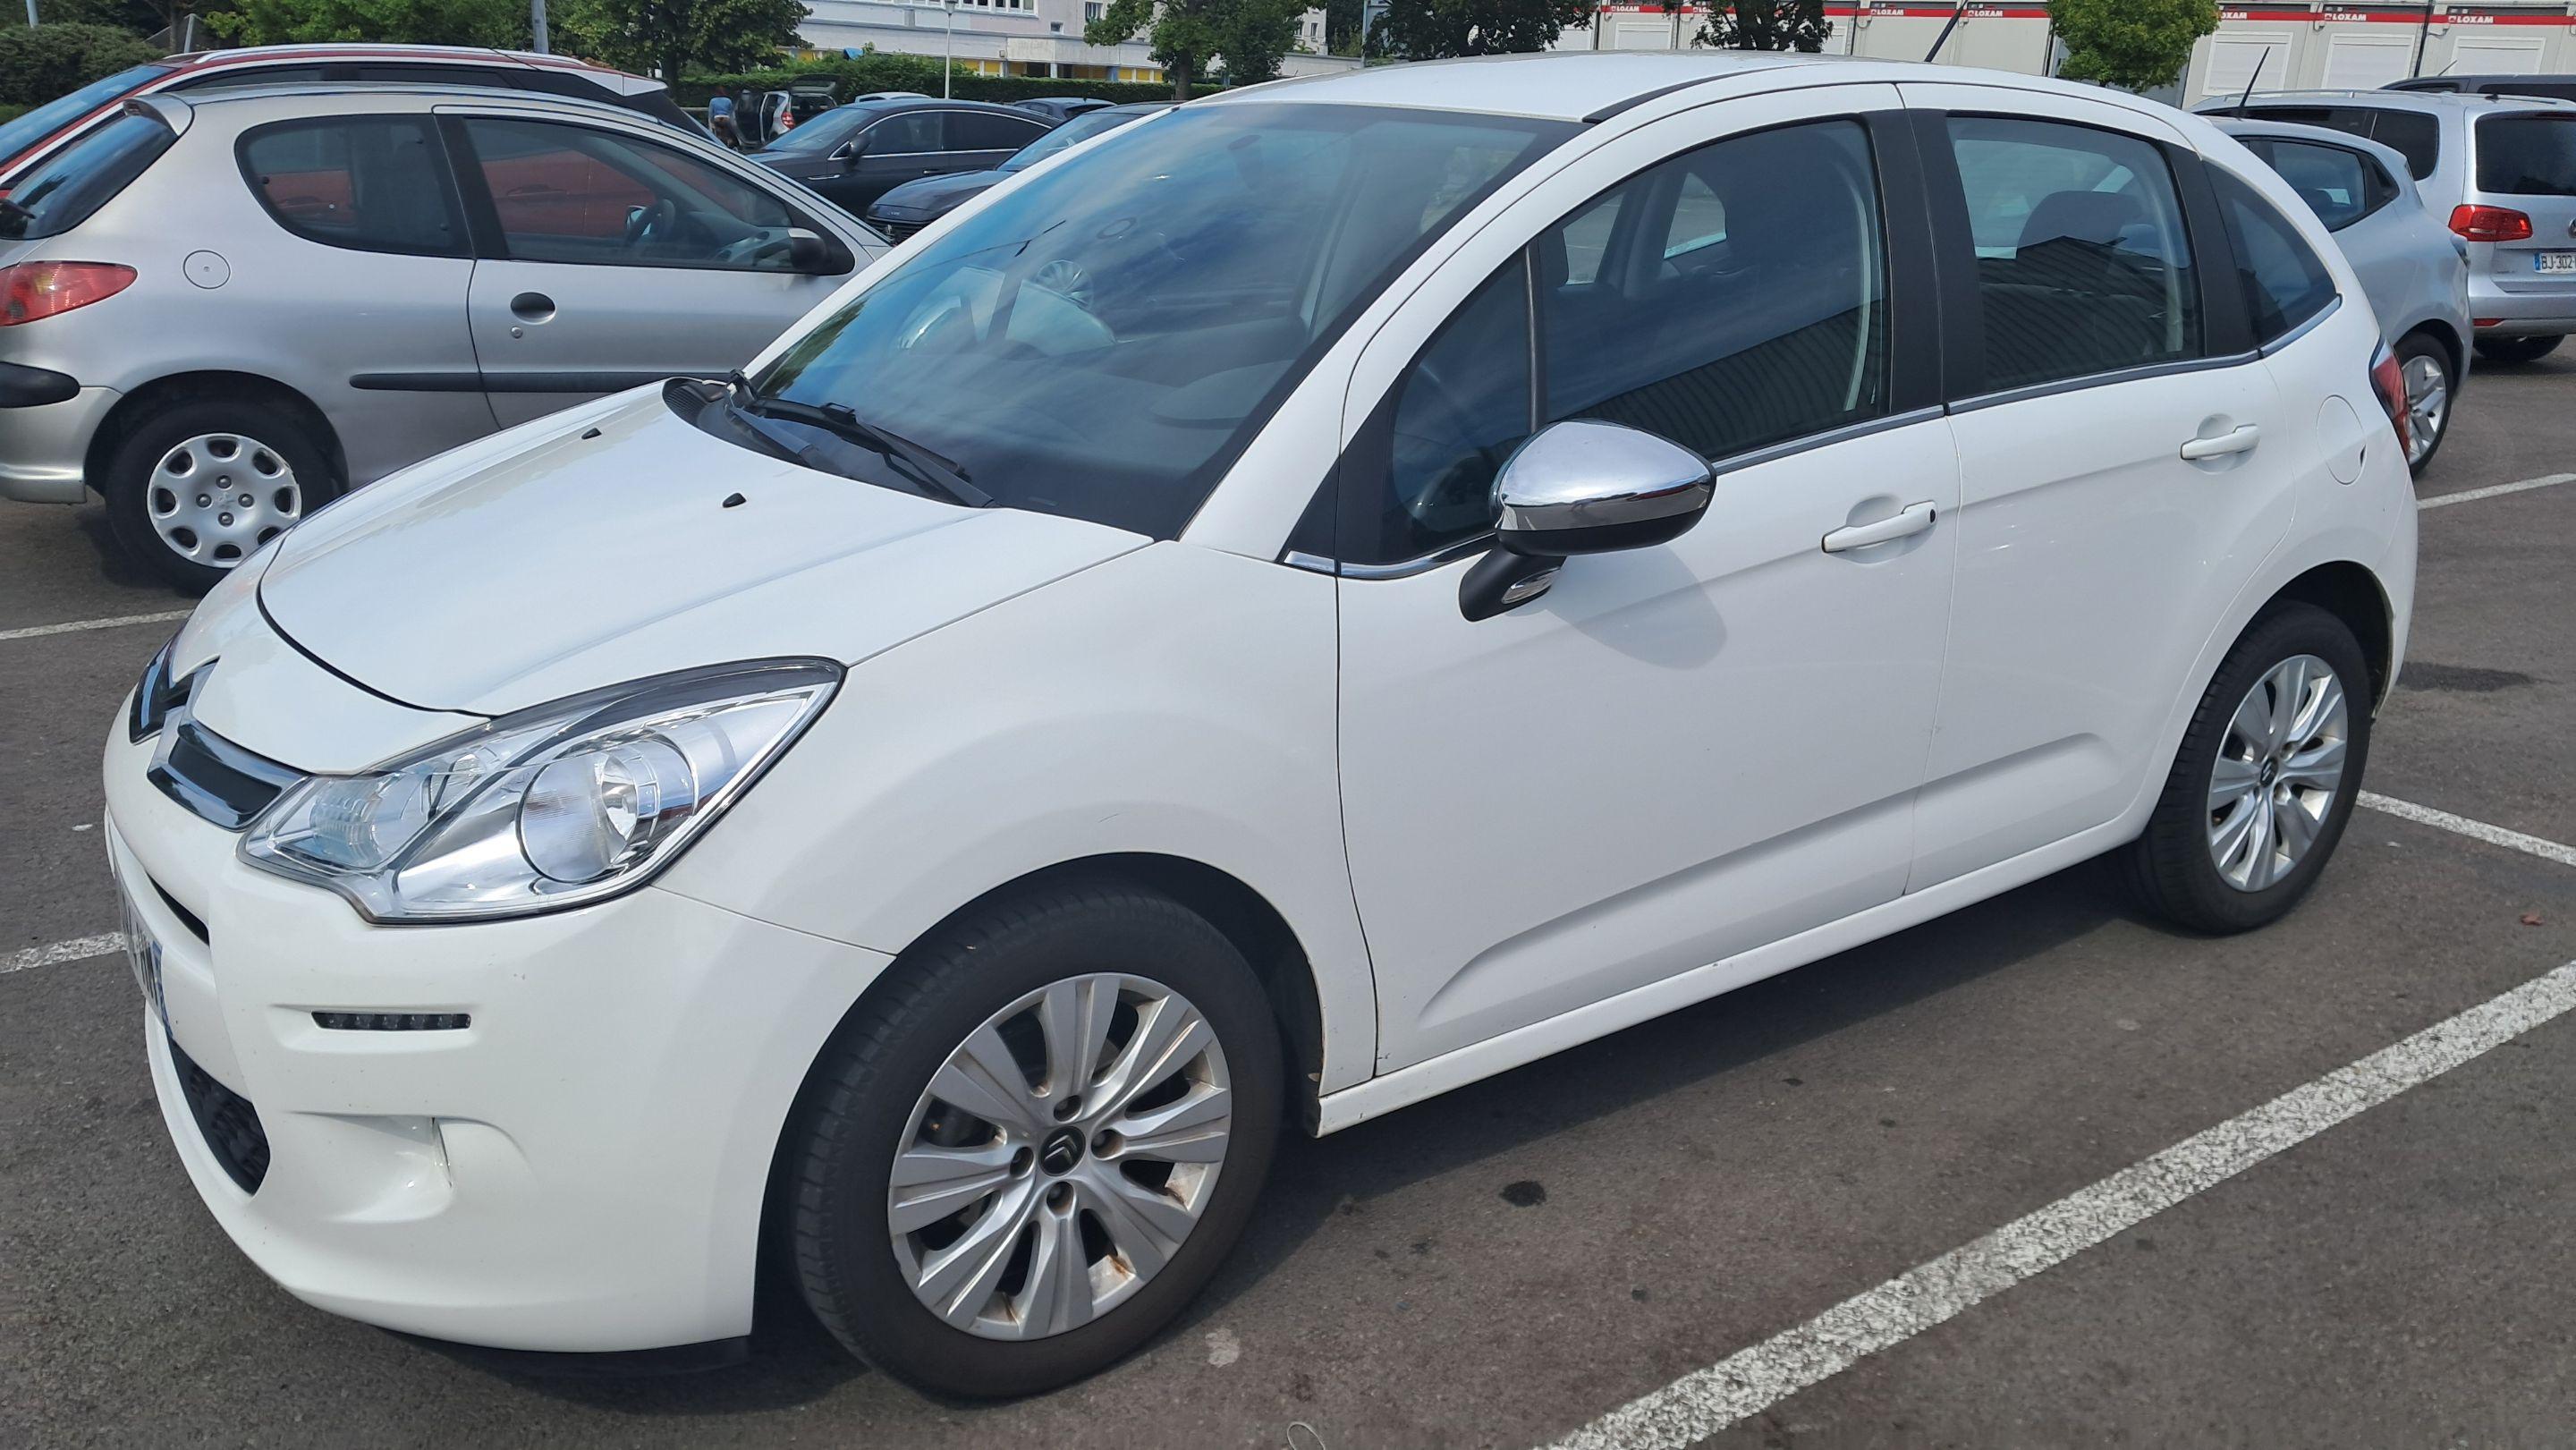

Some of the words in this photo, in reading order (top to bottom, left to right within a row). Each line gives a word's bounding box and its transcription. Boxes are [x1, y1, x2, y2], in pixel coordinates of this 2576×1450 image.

[2221, 12, 2248, 20] OXAM
[2332, 13, 2367, 21] LOXAM
[2456, 15, 2495, 24] LOXAM
[2541, 254, 2576, 270] BJ-302-
